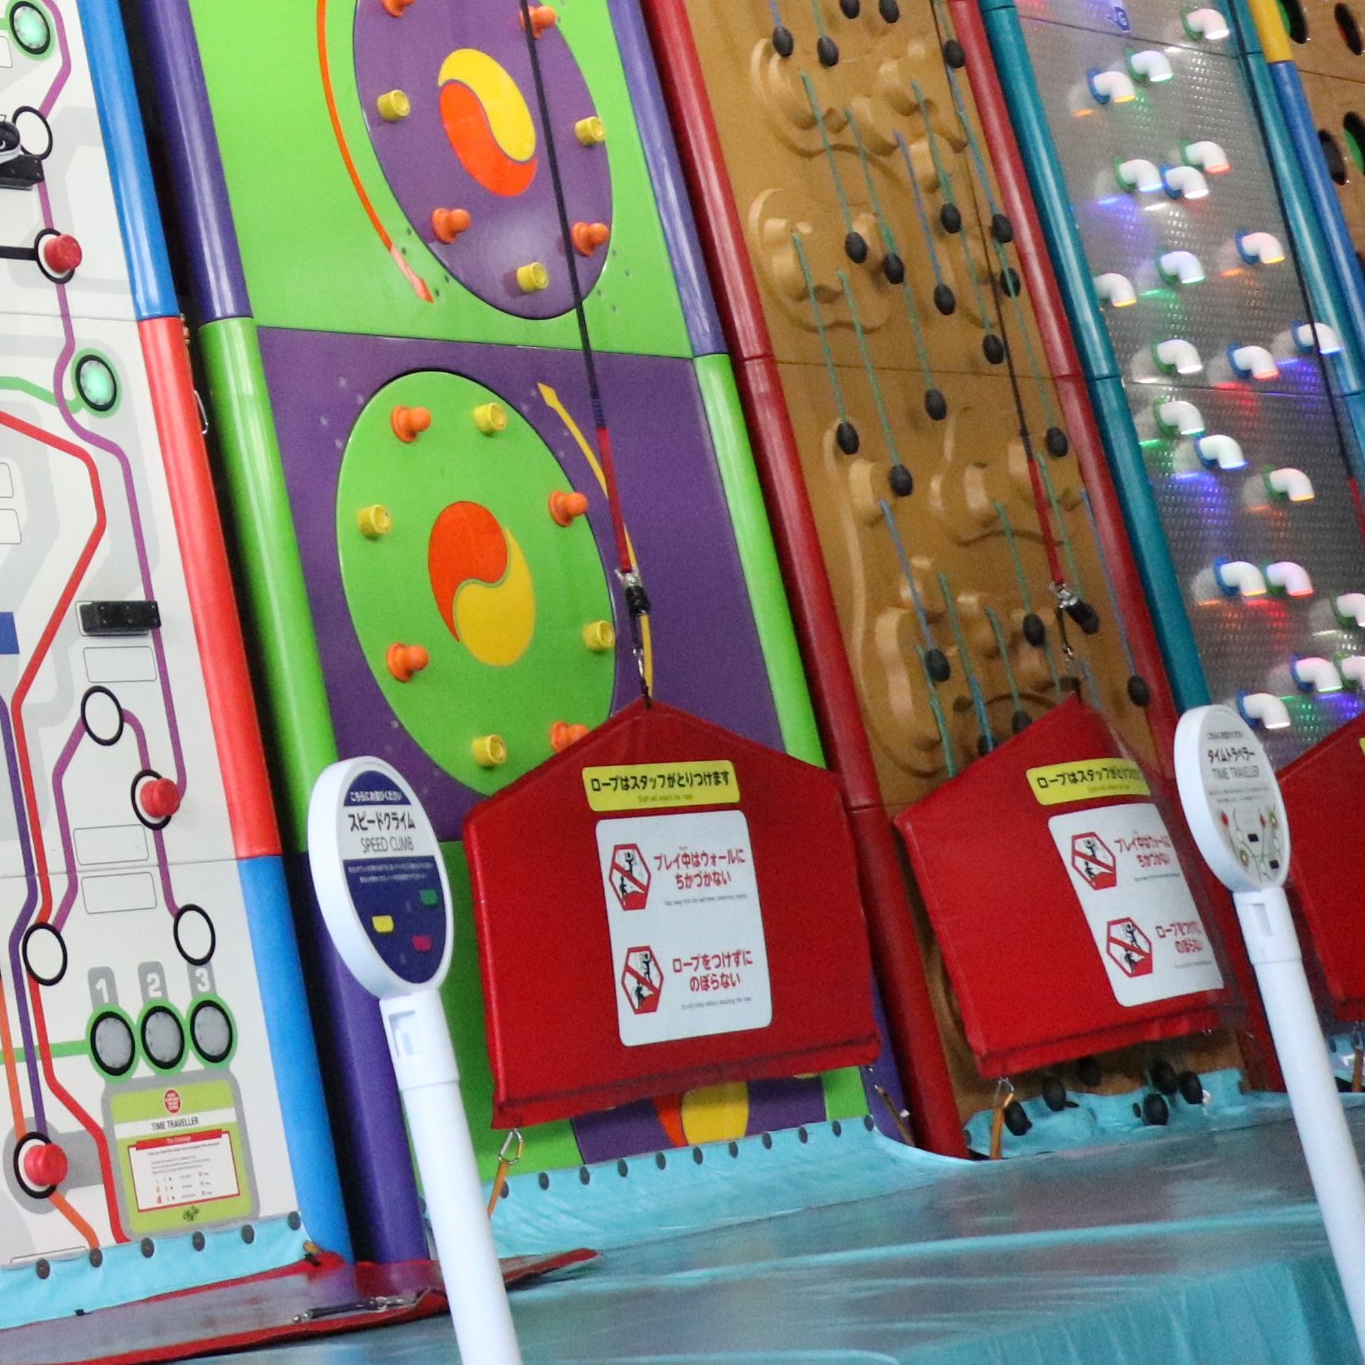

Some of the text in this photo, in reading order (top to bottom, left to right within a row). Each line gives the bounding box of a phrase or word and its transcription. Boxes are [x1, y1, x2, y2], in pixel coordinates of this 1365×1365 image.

[590, 770, 730, 792] ロープはスタッフがとりつけます
[347, 811, 416, 832] スピードクライム
[360, 835, 414, 853] SPEED CLIMB
[675, 870, 732, 890] ちかづかない
[672, 949, 754, 974] ロープをつけずに
[95, 967, 212, 1004] 1 2 3
[689, 972, 741, 992] のぼらない
